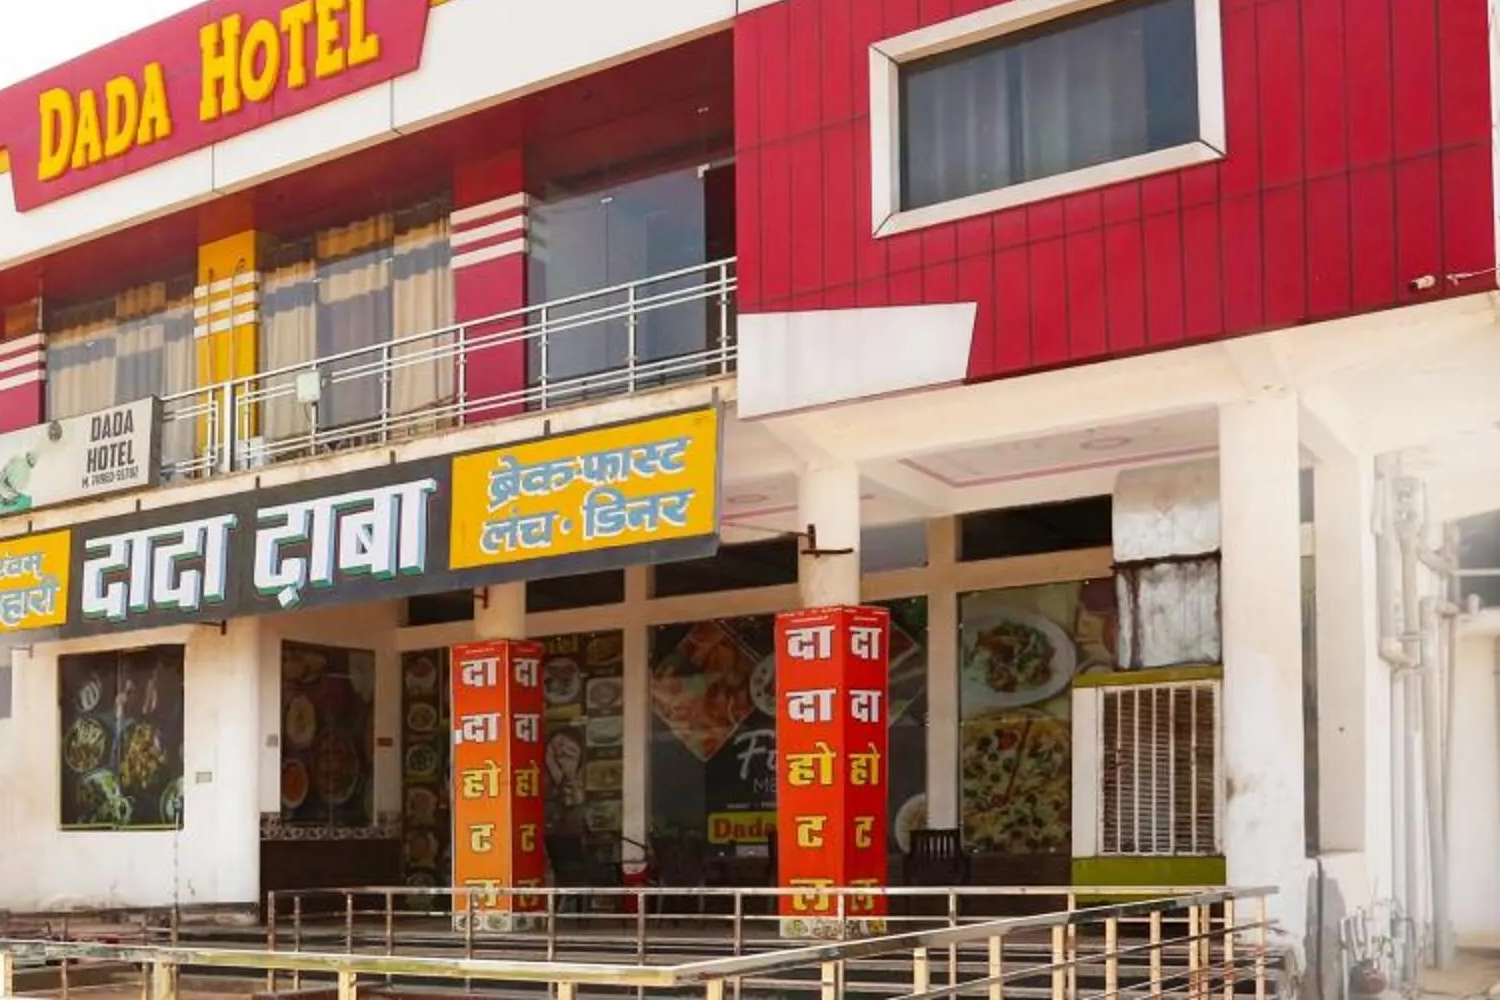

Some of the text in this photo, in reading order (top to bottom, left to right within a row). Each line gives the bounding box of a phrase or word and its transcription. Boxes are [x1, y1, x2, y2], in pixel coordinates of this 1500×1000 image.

[38, 62, 172, 182] DADA
[87, 440, 134, 473] HOTEL
[90, 410, 134, 442] DADA
[481, 486, 695, 554] लंच डिनर
[82, 514, 238, 621] दादा
